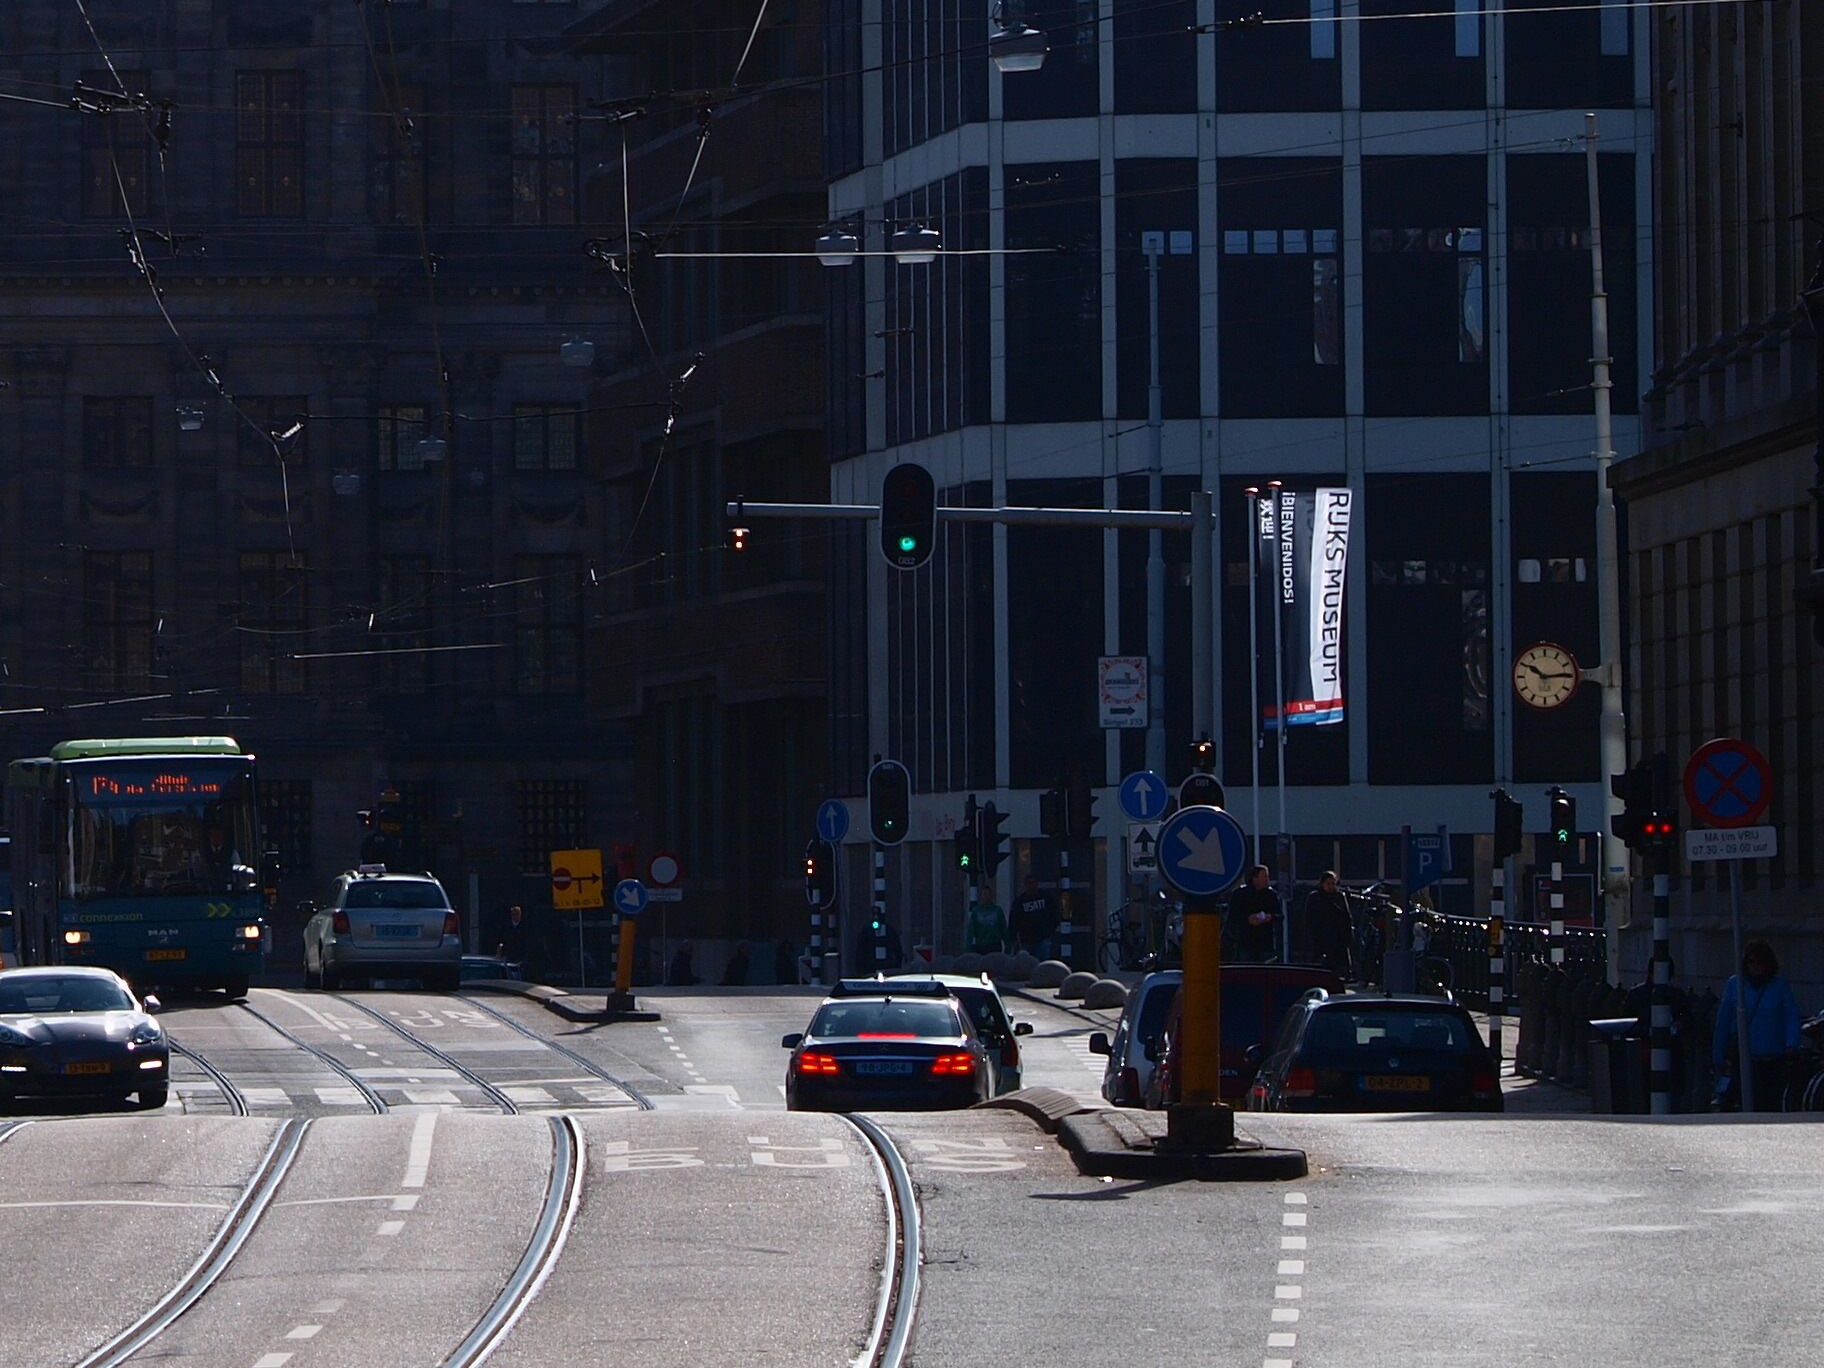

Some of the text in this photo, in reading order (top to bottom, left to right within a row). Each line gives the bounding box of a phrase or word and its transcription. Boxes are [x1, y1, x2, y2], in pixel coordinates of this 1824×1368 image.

[1323, 569, 1342, 682] MUSEUM
[1418, 851, 1433, 875] P
[147, 929, 179, 937] MAN
